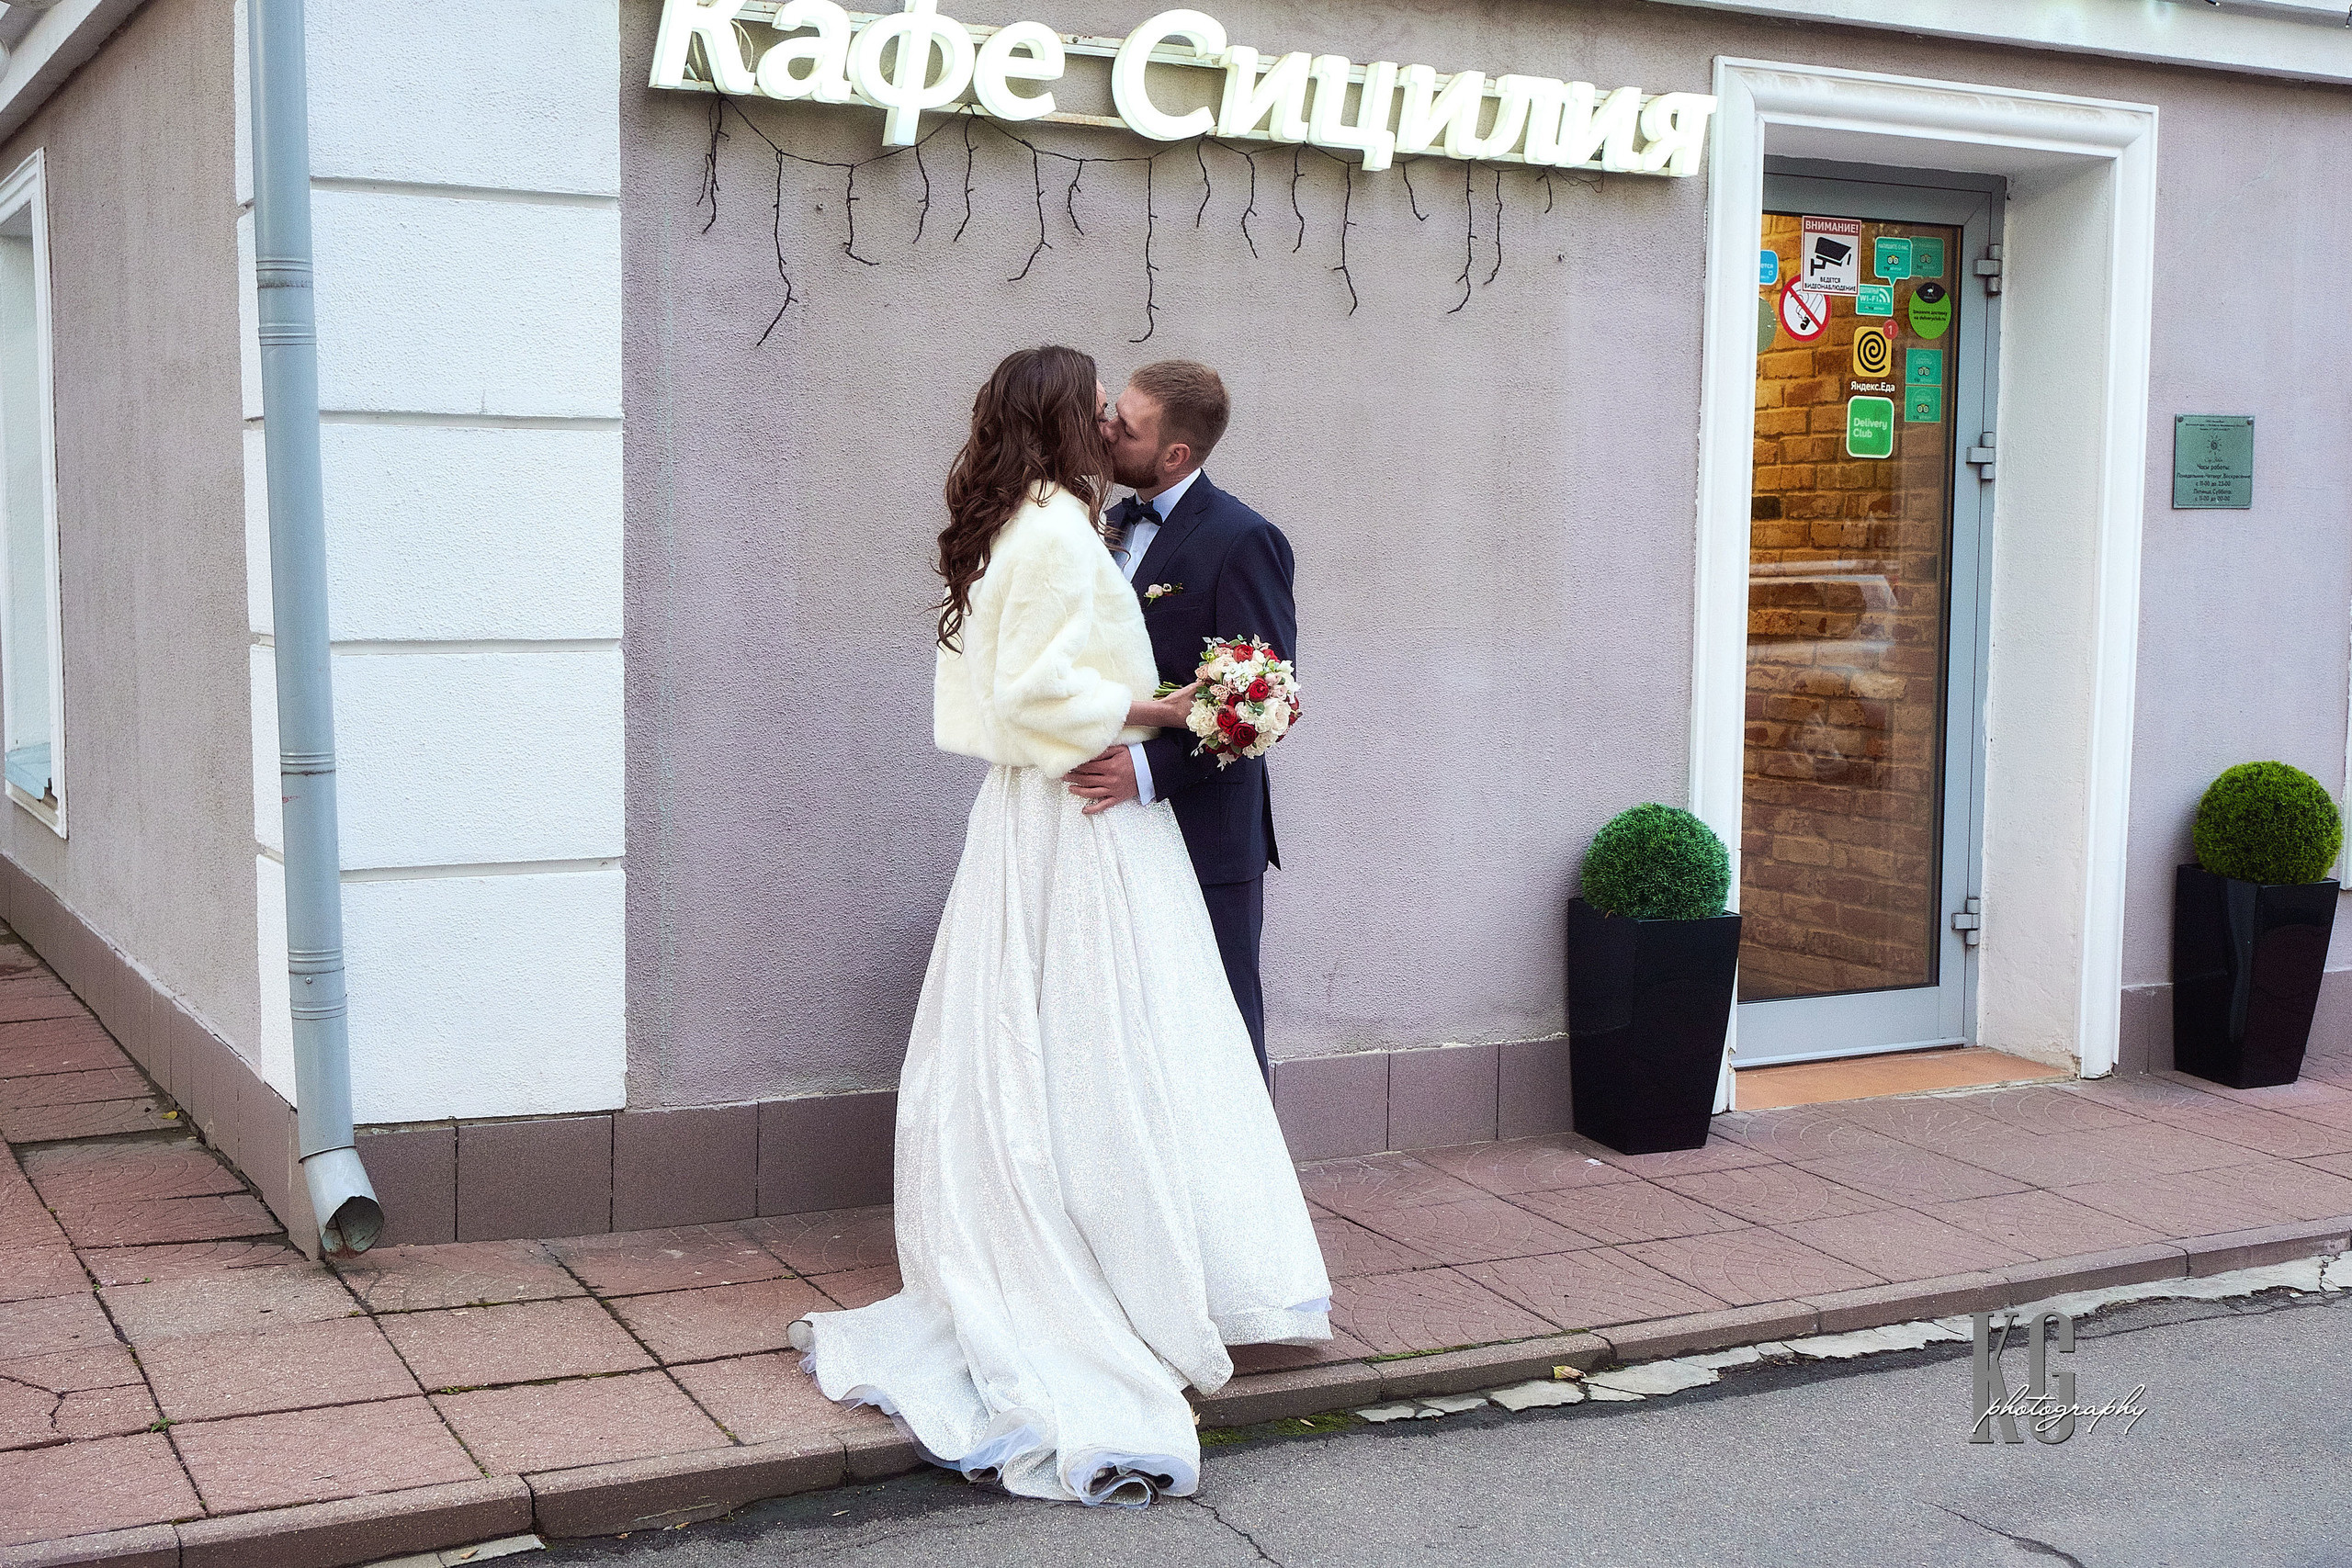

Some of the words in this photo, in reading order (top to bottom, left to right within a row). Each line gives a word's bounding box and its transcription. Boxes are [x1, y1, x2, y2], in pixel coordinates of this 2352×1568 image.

[649, 0, 1066, 147] Кафе
[1112, 7, 1717, 178] Сицилия
[1804, 220, 1860, 234] ВНИМАНИЕ!
[1820, 276, 1841, 284] ВЕДЕТСЯ
[1804, 283, 1857, 292] ВИДЕОНАБЛЮДЕНИЕ
[1888, 324, 1894, 335] 1
[1850, 380, 1895, 392] Яндекс.Еда
[1853, 417, 1888, 431] Delivery
[1852, 428, 1873, 438] Club
